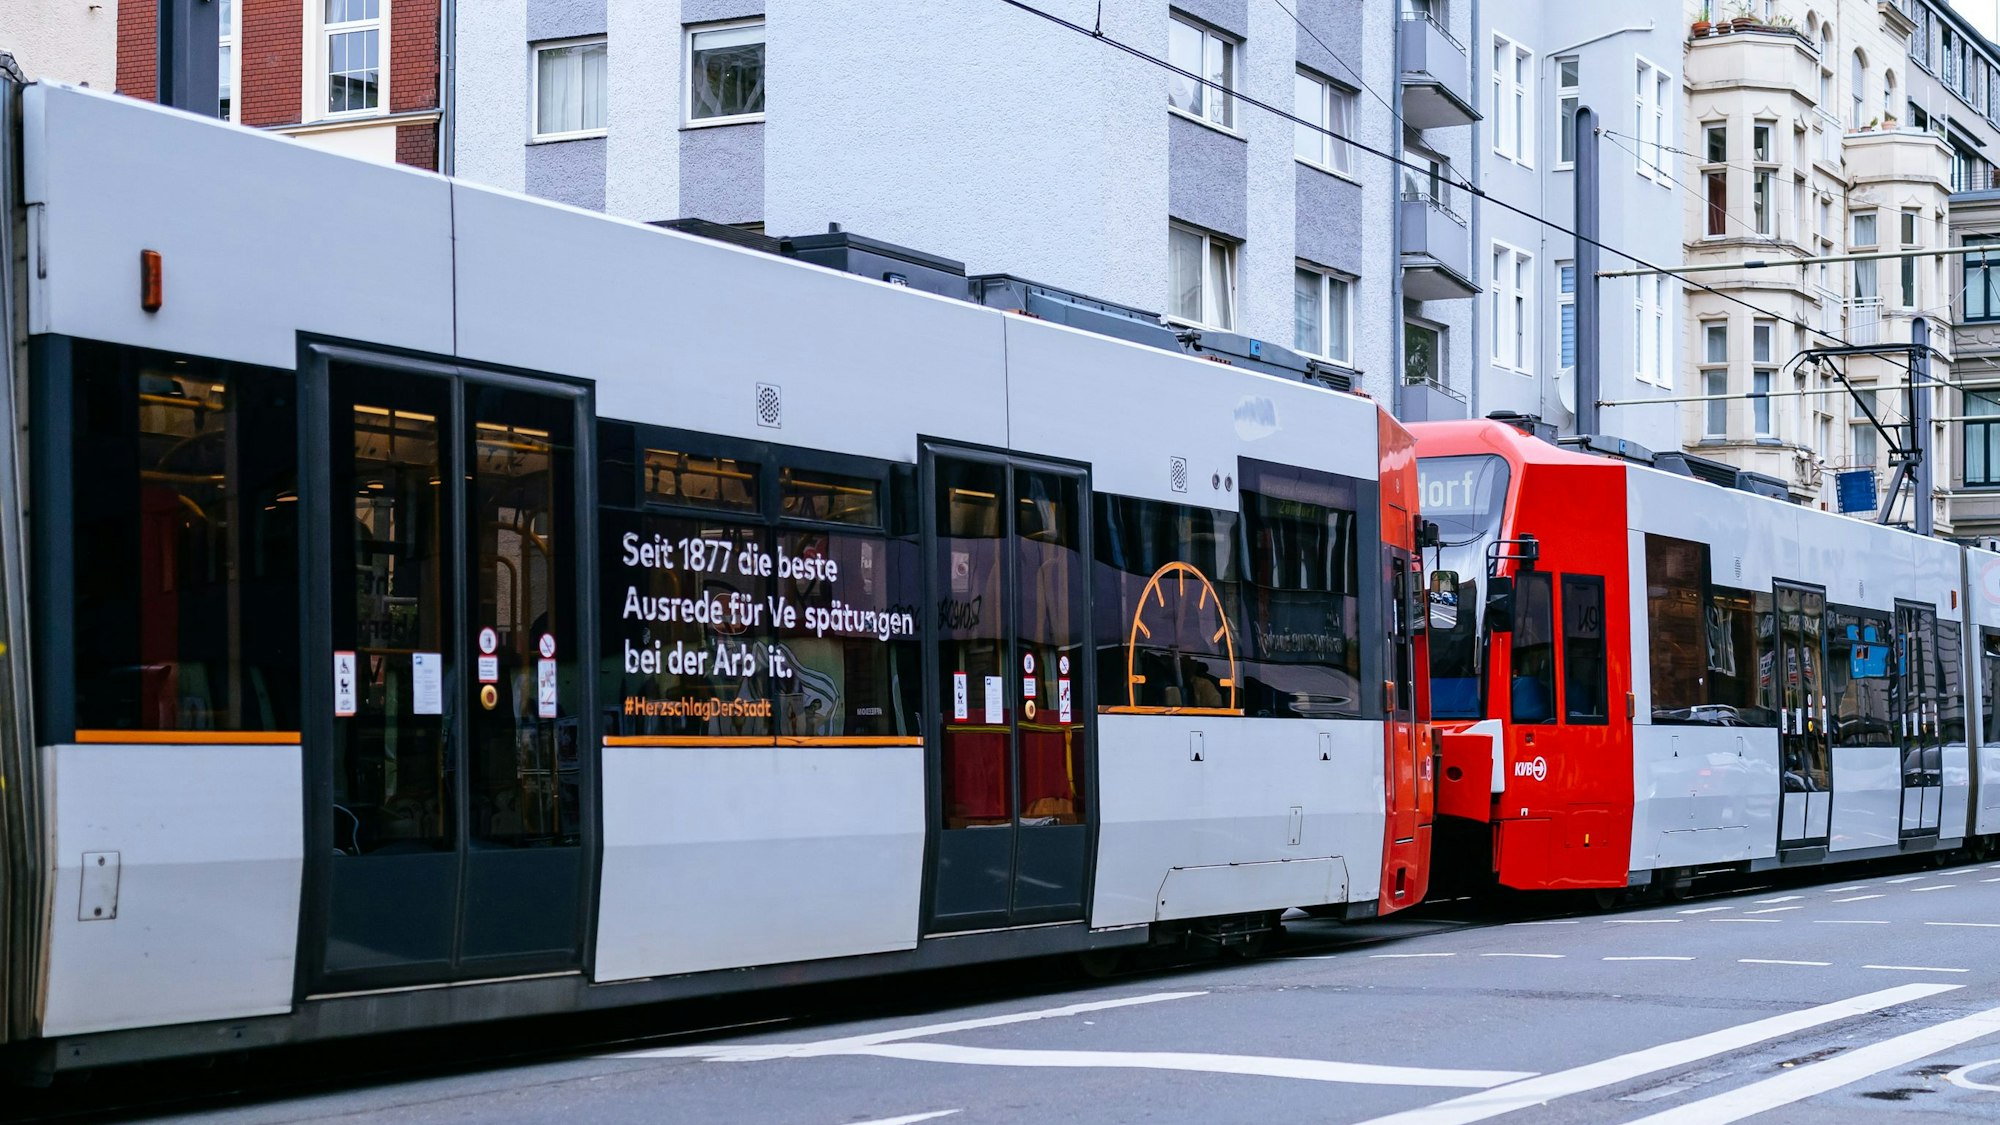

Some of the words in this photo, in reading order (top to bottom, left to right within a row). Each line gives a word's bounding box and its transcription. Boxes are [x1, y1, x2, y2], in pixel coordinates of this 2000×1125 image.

[622, 532, 674, 570] Seit
[678, 537, 733, 573] 1877
[738, 542, 772, 577] die
[777, 545, 838, 583] beste
[622, 586, 723, 625] Ausrede
[728, 591, 764, 627] für
[624, 638, 662, 675] bei
[667, 640, 709, 675] der
[624, 696, 772, 721] #HerzschlagDerStadt
[1514, 761, 1533, 777] KVB
